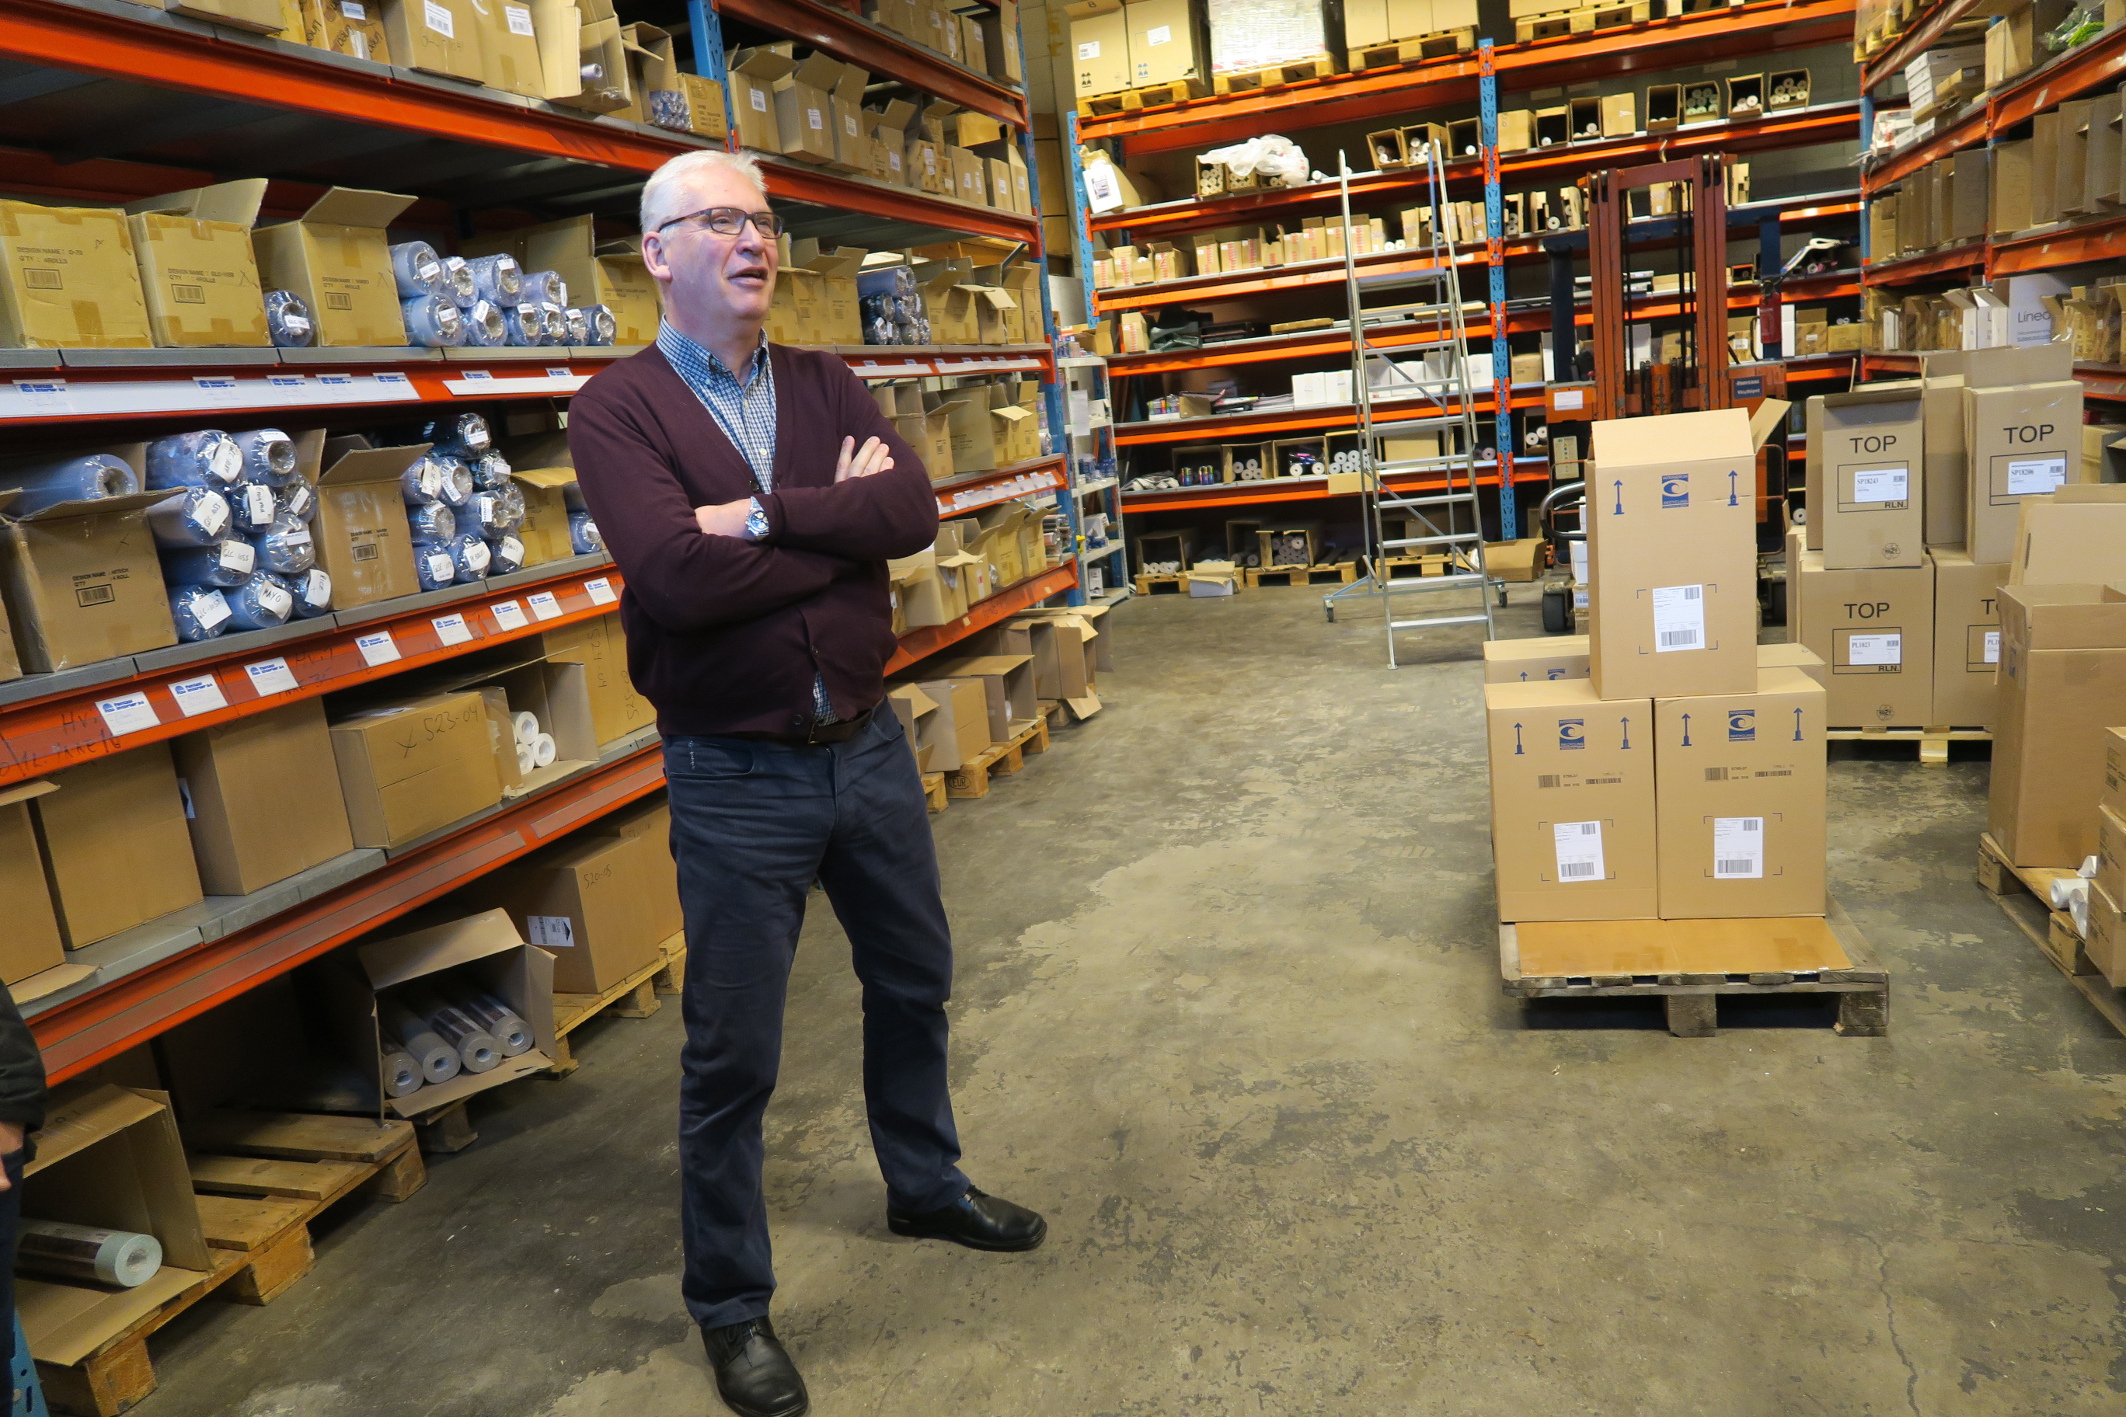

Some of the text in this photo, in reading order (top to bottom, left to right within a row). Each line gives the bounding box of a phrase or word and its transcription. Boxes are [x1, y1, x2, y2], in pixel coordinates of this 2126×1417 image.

[2003, 424, 2054, 444] TOP
[1849, 435, 1897, 454] TOP
[1844, 602, 1890, 619] TOP
[1981, 599, 1999, 615] T
